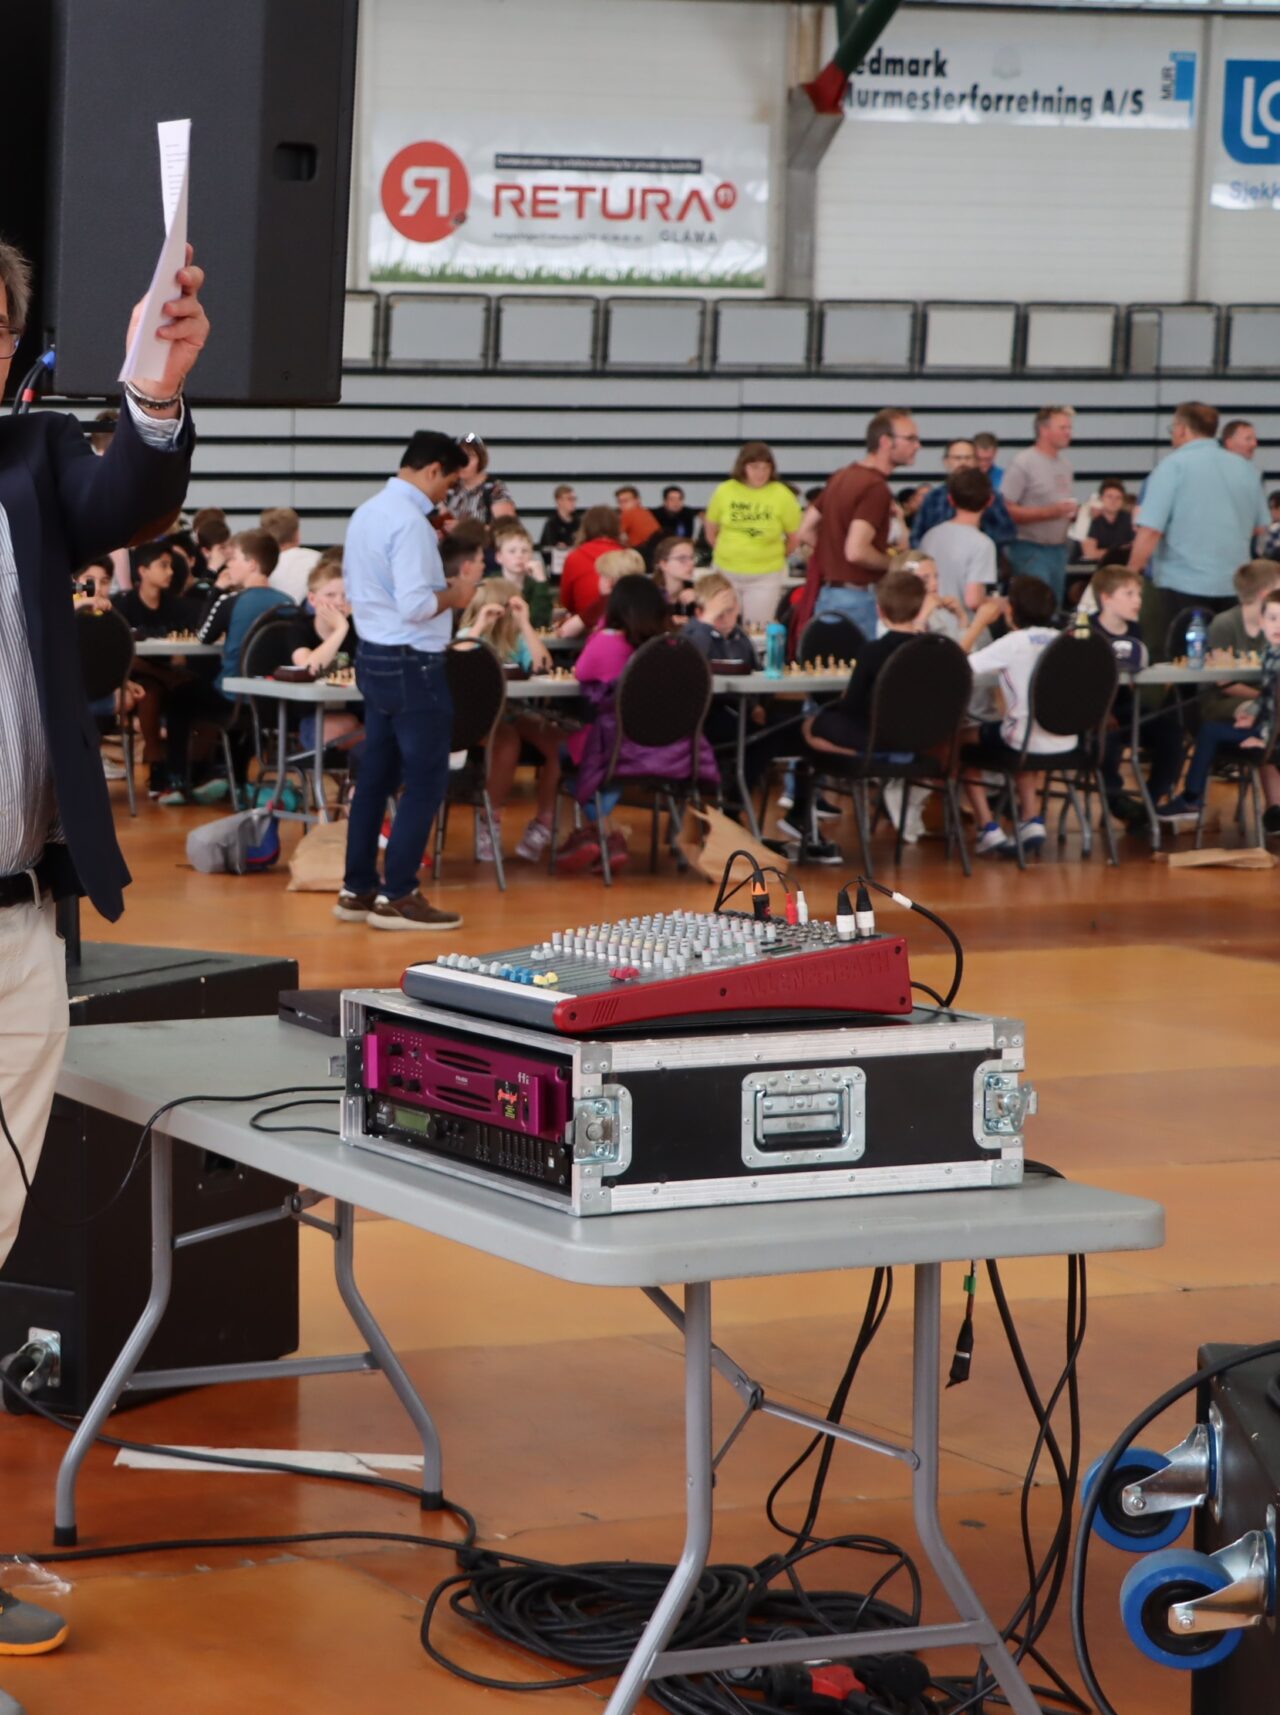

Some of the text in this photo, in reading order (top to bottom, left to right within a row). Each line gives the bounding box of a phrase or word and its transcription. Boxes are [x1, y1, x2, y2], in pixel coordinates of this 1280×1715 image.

[854, 48, 947, 77] dmark
[1102, 89, 1144, 115] A/S
[493, 183, 714, 222] RETURA
